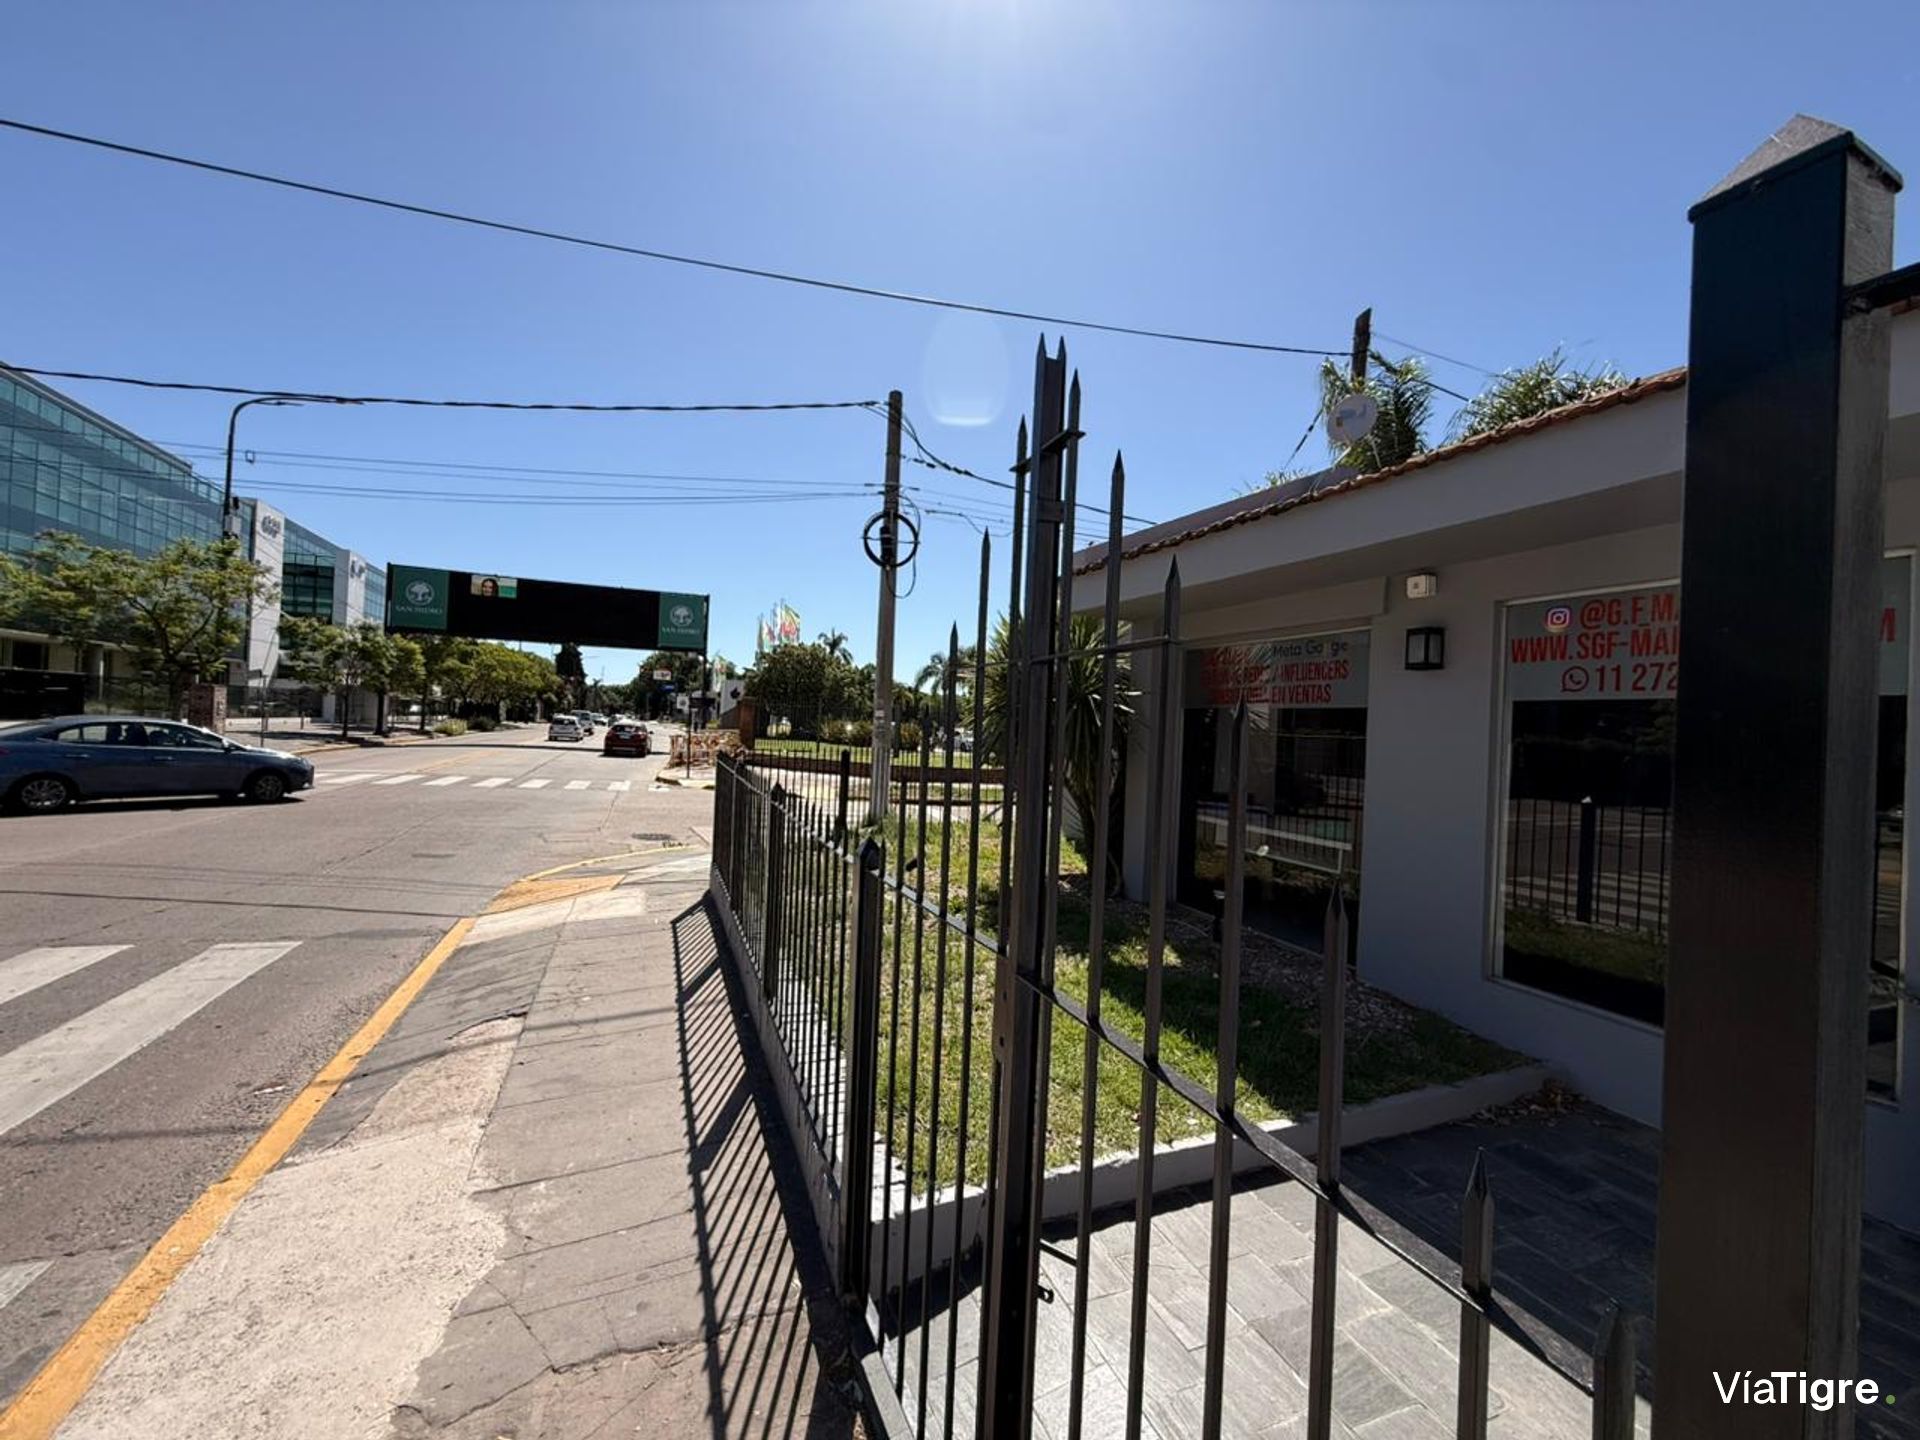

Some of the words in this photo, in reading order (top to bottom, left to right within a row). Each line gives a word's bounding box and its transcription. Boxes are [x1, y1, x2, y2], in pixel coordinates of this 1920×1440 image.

[1580, 592, 1680, 630] @G.F_M
[1306, 639, 1349, 657] Goge
[1280, 659, 1350, 682] INFLUENCERS
[1595, 664, 1622, 692] 11
[1288, 683, 1332, 704] VENTAS
